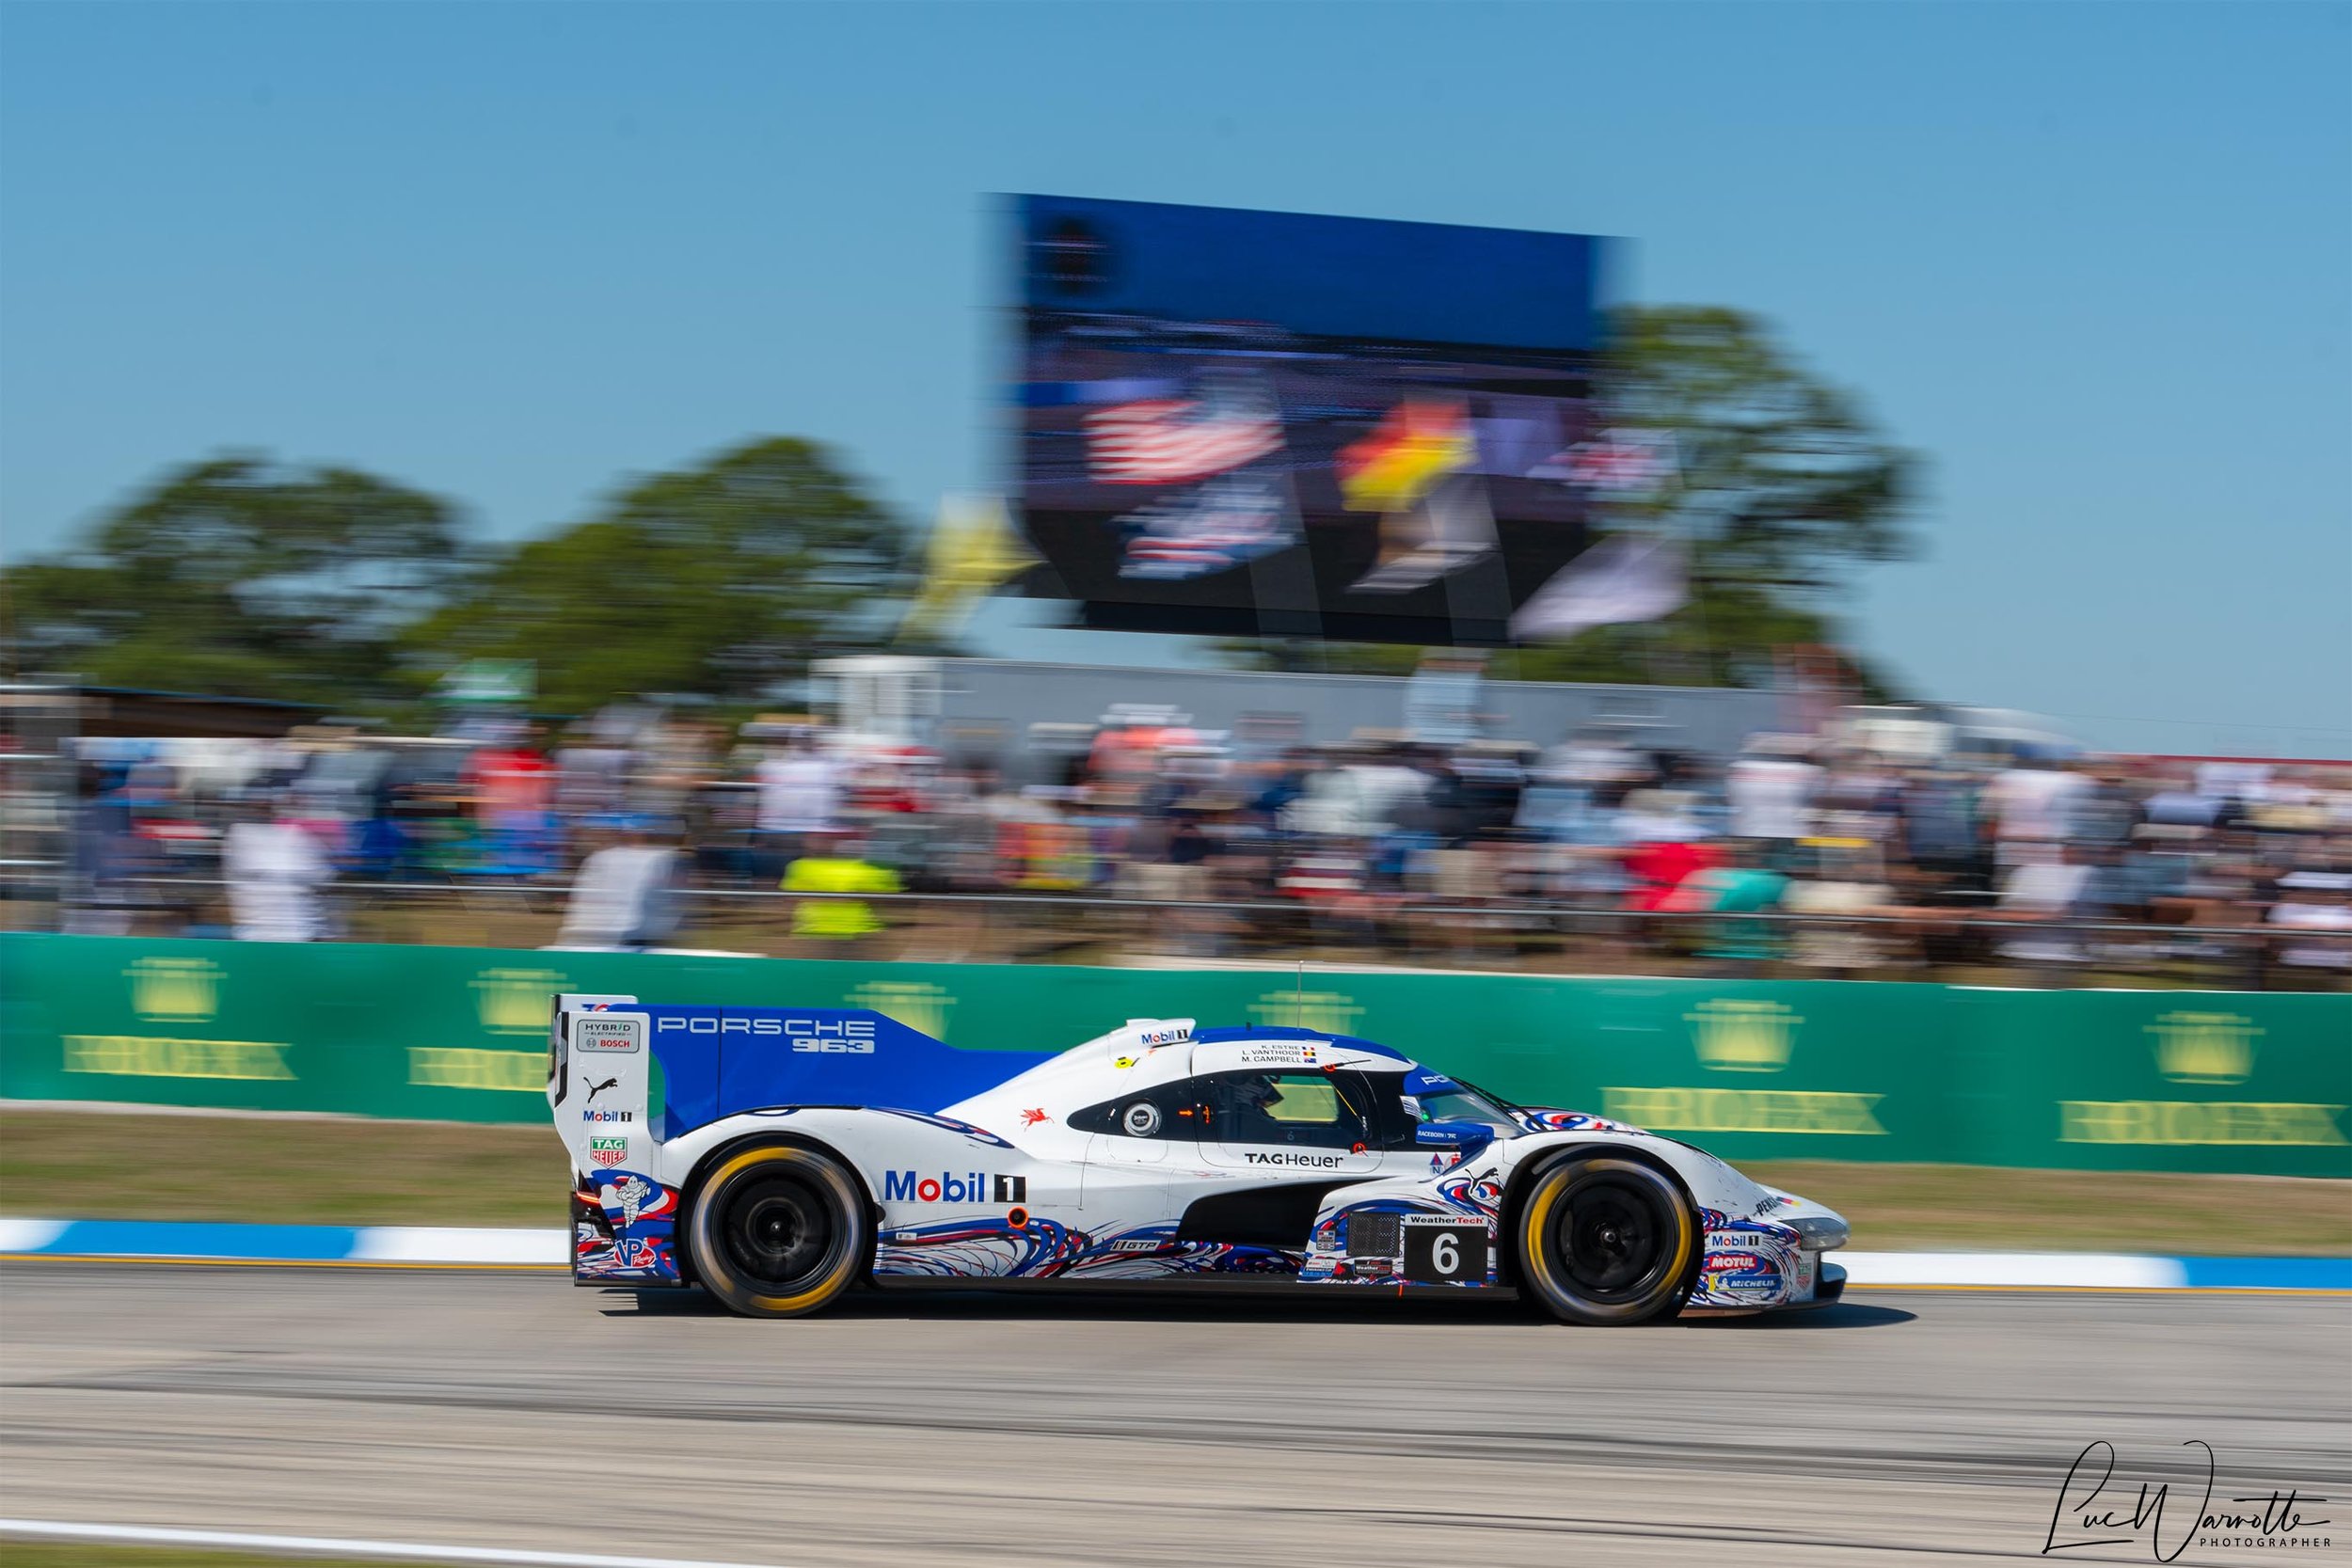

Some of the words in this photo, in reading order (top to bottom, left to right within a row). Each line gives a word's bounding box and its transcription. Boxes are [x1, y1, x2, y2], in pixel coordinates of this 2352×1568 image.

[585, 1023, 631, 1032] HYBRID
[658, 1017, 875, 1037] PORSCHE
[1141, 1030, 1175, 1044] Mobil
[600, 1039, 630, 1048] BOSCH
[792, 1038, 875, 1053] 963
[583, 1111, 618, 1122] Mobil
[594, 1139, 623, 1149] TAG
[593, 1150, 625, 1166] HEUER
[885, 1170, 985, 1202] Mobil
[1712, 1235, 1746, 1246] Mobil
[615, 1238, 644, 1268] VP
[1432, 1232, 1459, 1275] 6
[1711, 1257, 1756, 1268] MOTUL
[1731, 1279, 1776, 1288] MICHELIN
